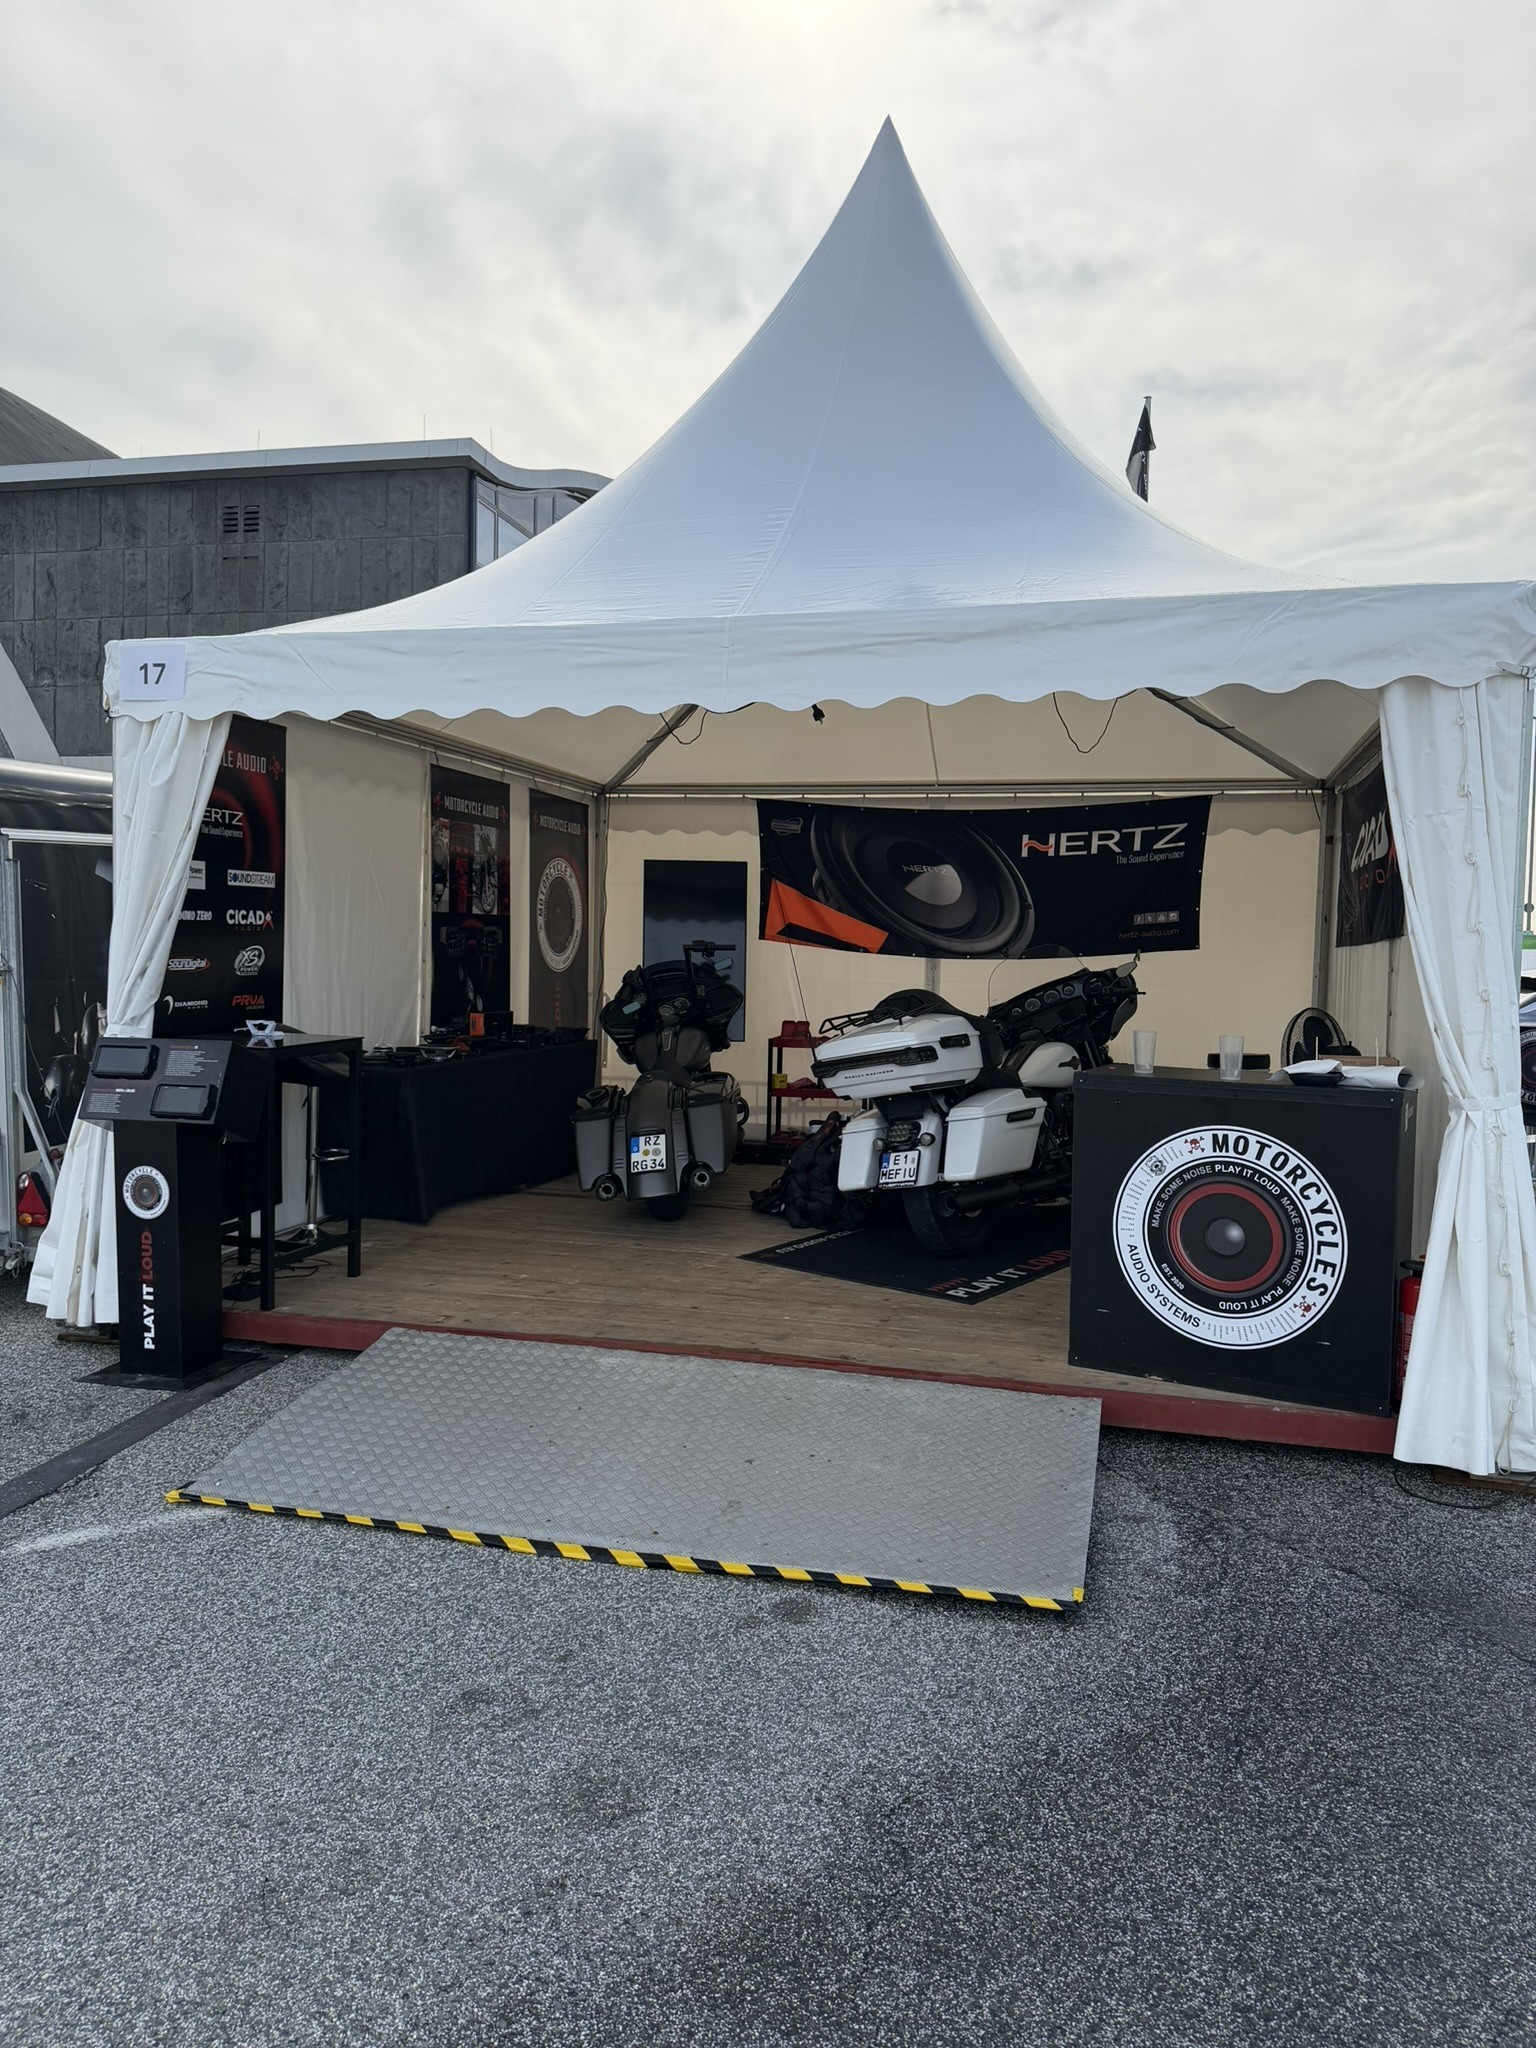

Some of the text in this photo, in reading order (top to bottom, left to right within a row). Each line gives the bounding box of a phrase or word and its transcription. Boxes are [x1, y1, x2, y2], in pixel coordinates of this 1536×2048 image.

[139, 663, 166, 685] 17
[236, 753, 267, 774] AUDIO
[202, 808, 243, 825] ERTZ
[444, 795, 500, 819] MOTORCYCLE AUDIO
[539, 814, 581, 835] MOTORCYCLE AUDIO
[1021, 822, 1188, 858] HERTZ
[1116, 850, 1185, 864] The Sound Experience
[228, 872, 274, 885] SOUNDSTREAM
[902, 864, 949, 875] HERTZ
[196, 910, 213, 920] ZERO
[174, 1000, 208, 1008] DIAMOND
[644, 1136, 660, 1146] RZ
[1212, 1133, 1339, 1297] MOTORCYCLES
[1151, 1164, 1304, 1310] MAKE SOME NOISE PLAY IT LOUD MAKE SOME NOISE PLAY IT LOUD
[945, 1276, 1006, 1298] PLAY
[995, 1267, 1028, 1279] IT
[1127, 1243, 1150, 1284] AUDIO
[1147, 1284, 1201, 1328] SYSTEMS
[1161, 1262, 1185, 1291] EST. 2020
[141, 1231, 155, 1350] PLAY IT LOUD
